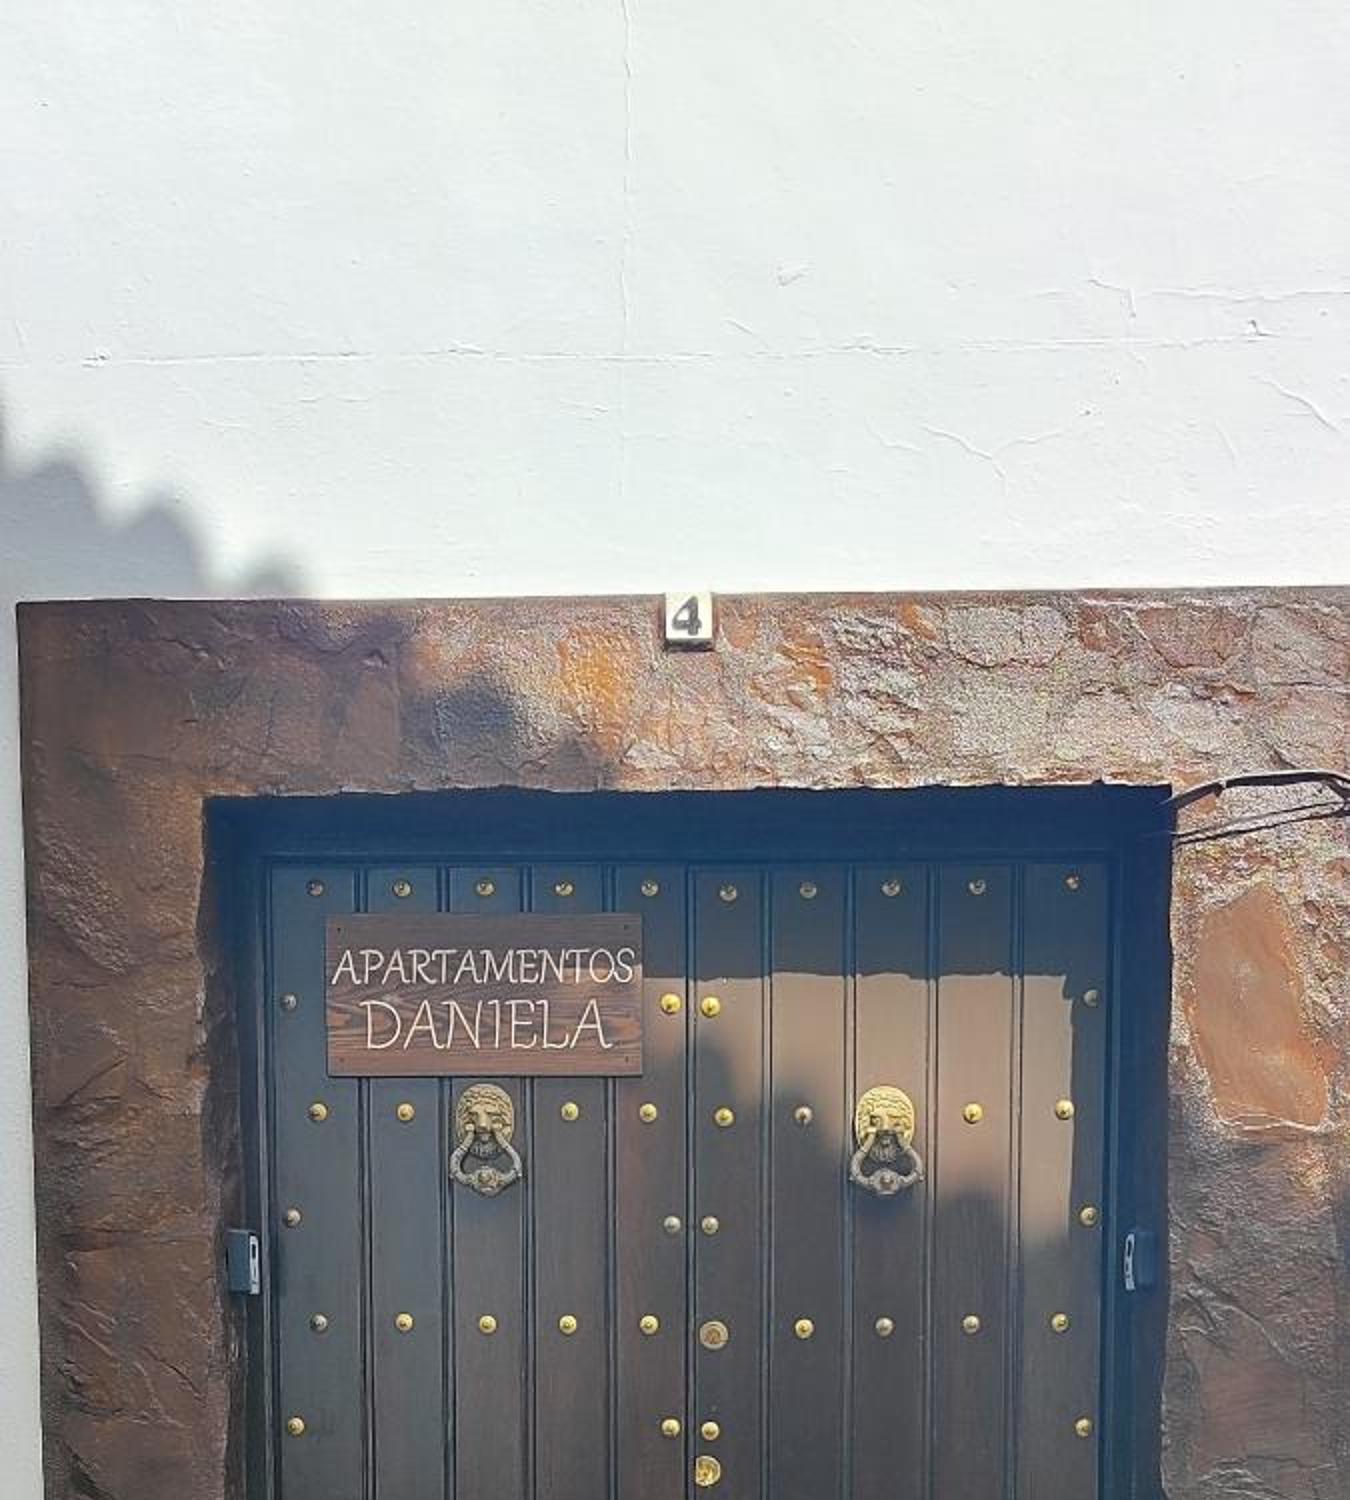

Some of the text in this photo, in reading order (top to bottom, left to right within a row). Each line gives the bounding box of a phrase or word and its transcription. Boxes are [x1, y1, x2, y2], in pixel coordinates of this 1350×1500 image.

[672, 596, 702, 635] 4
[331, 948, 635, 985] APARTAMENTOS
[359, 999, 613, 1049] DANIELA
